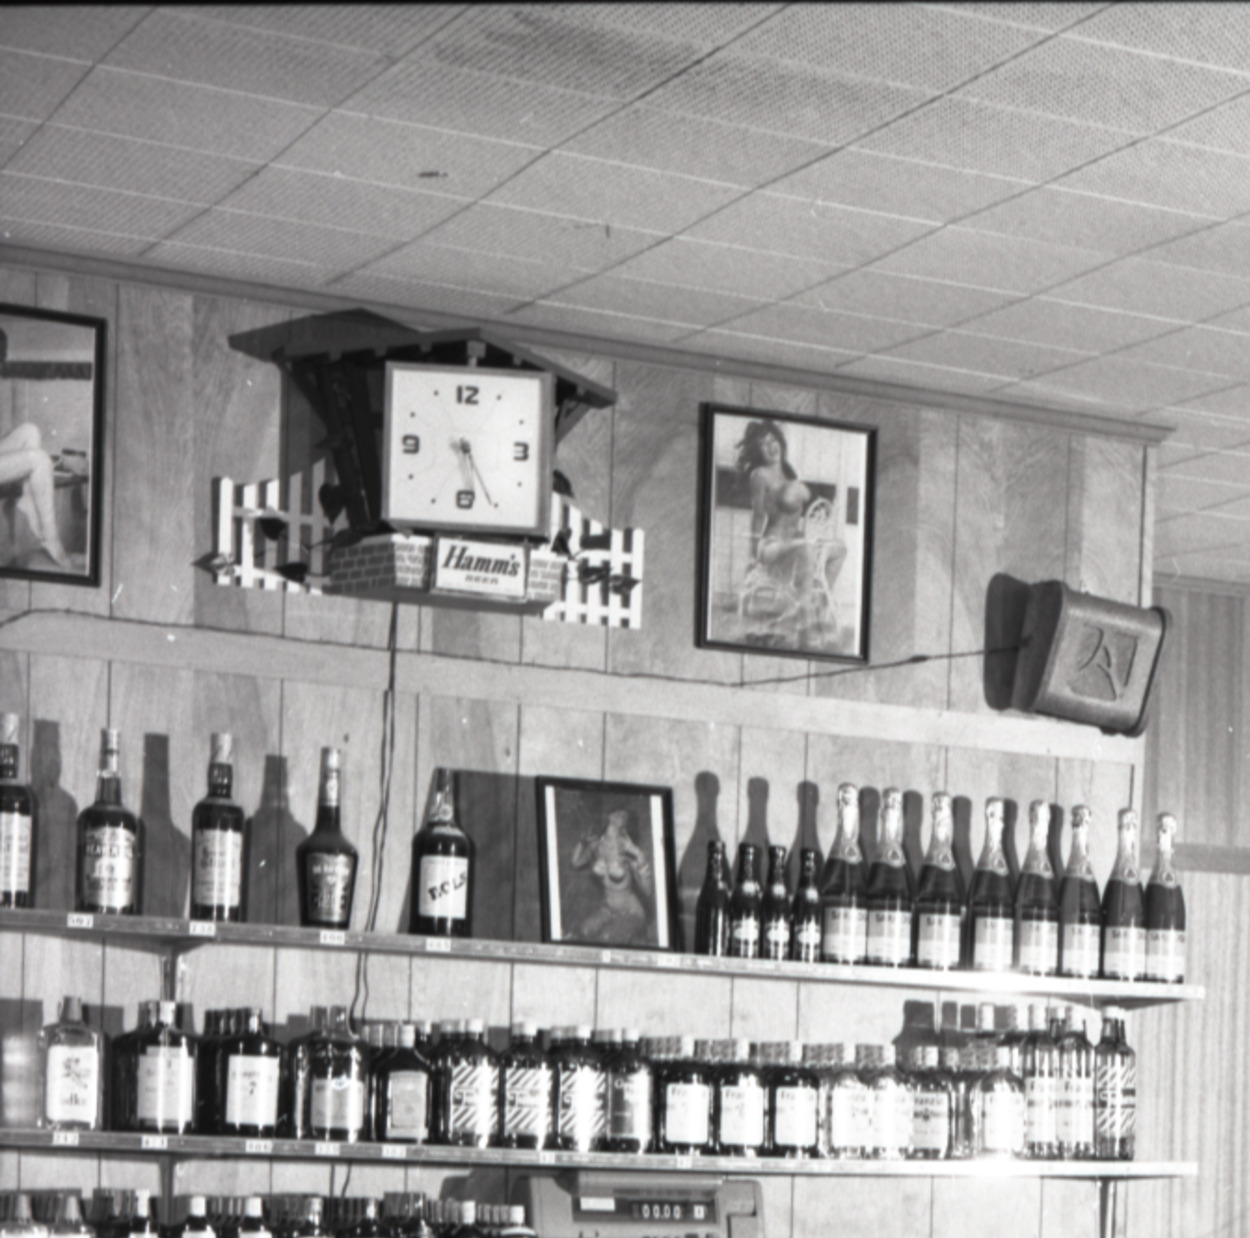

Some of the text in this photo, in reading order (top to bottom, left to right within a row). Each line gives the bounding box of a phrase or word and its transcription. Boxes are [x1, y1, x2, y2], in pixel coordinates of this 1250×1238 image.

[456, 386, 480, 405] 12
[402, 435, 420, 454] 9
[513, 443, 529, 461] 3
[442, 545, 522, 577] Hamm's
[464, 576, 500, 586] BEER
